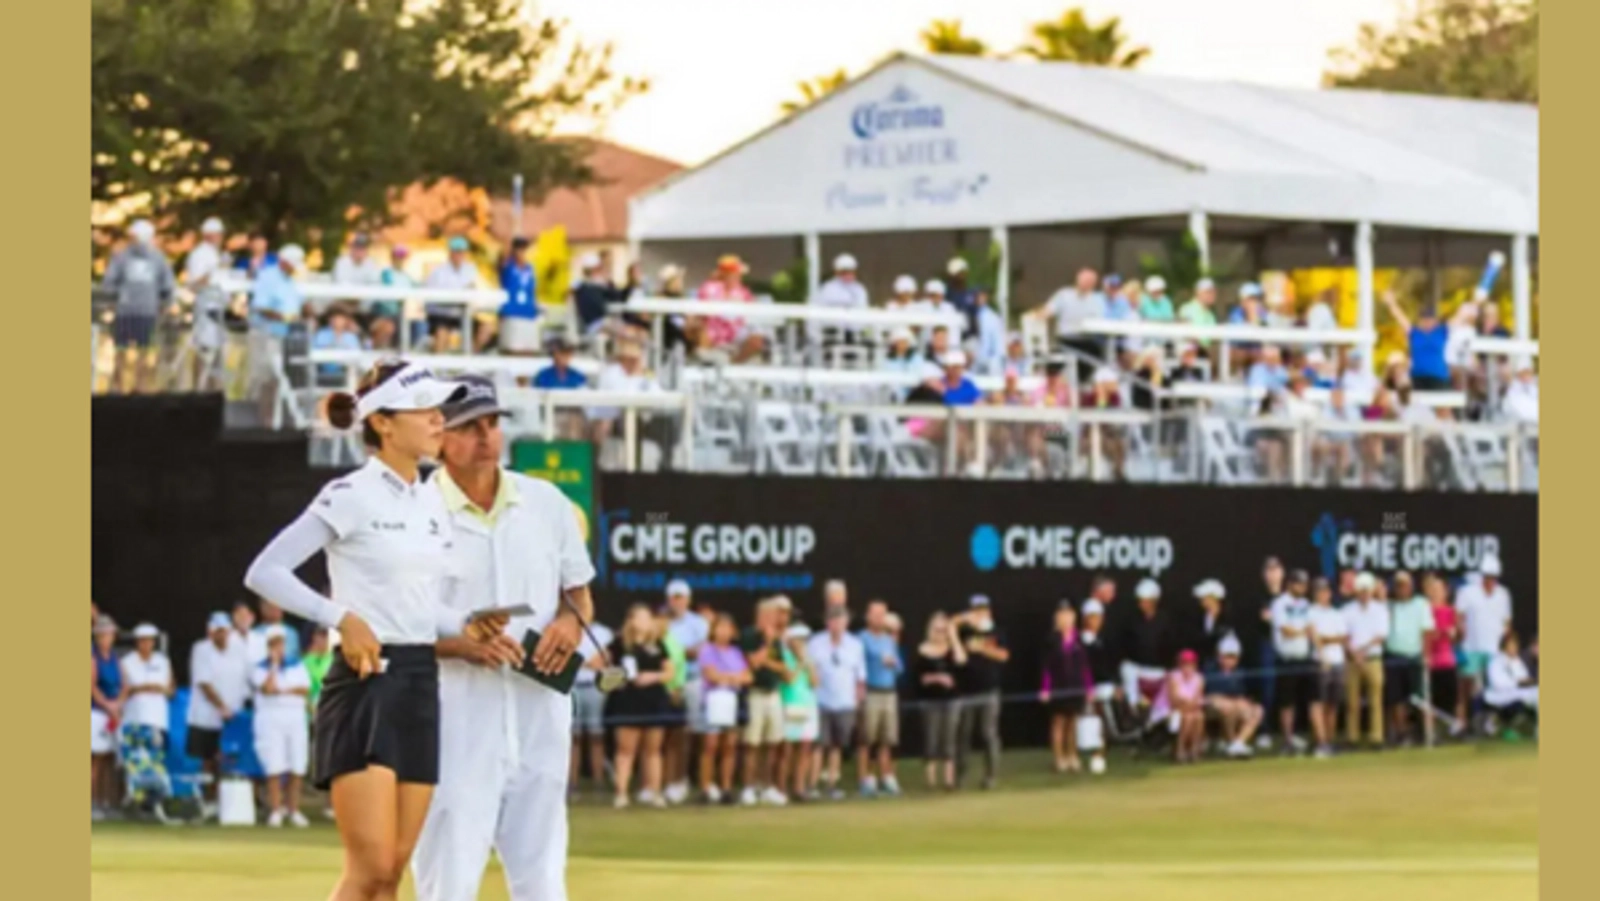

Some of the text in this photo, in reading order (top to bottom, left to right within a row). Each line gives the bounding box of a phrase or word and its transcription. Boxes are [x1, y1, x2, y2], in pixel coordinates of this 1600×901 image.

[852, 103, 944, 139] Corona
[843, 139, 958, 168] PREMIER
[610, 524, 816, 563] CME GROUP
[1003, 526, 1173, 577] CME Group
[1338, 532, 1397, 569] CME
